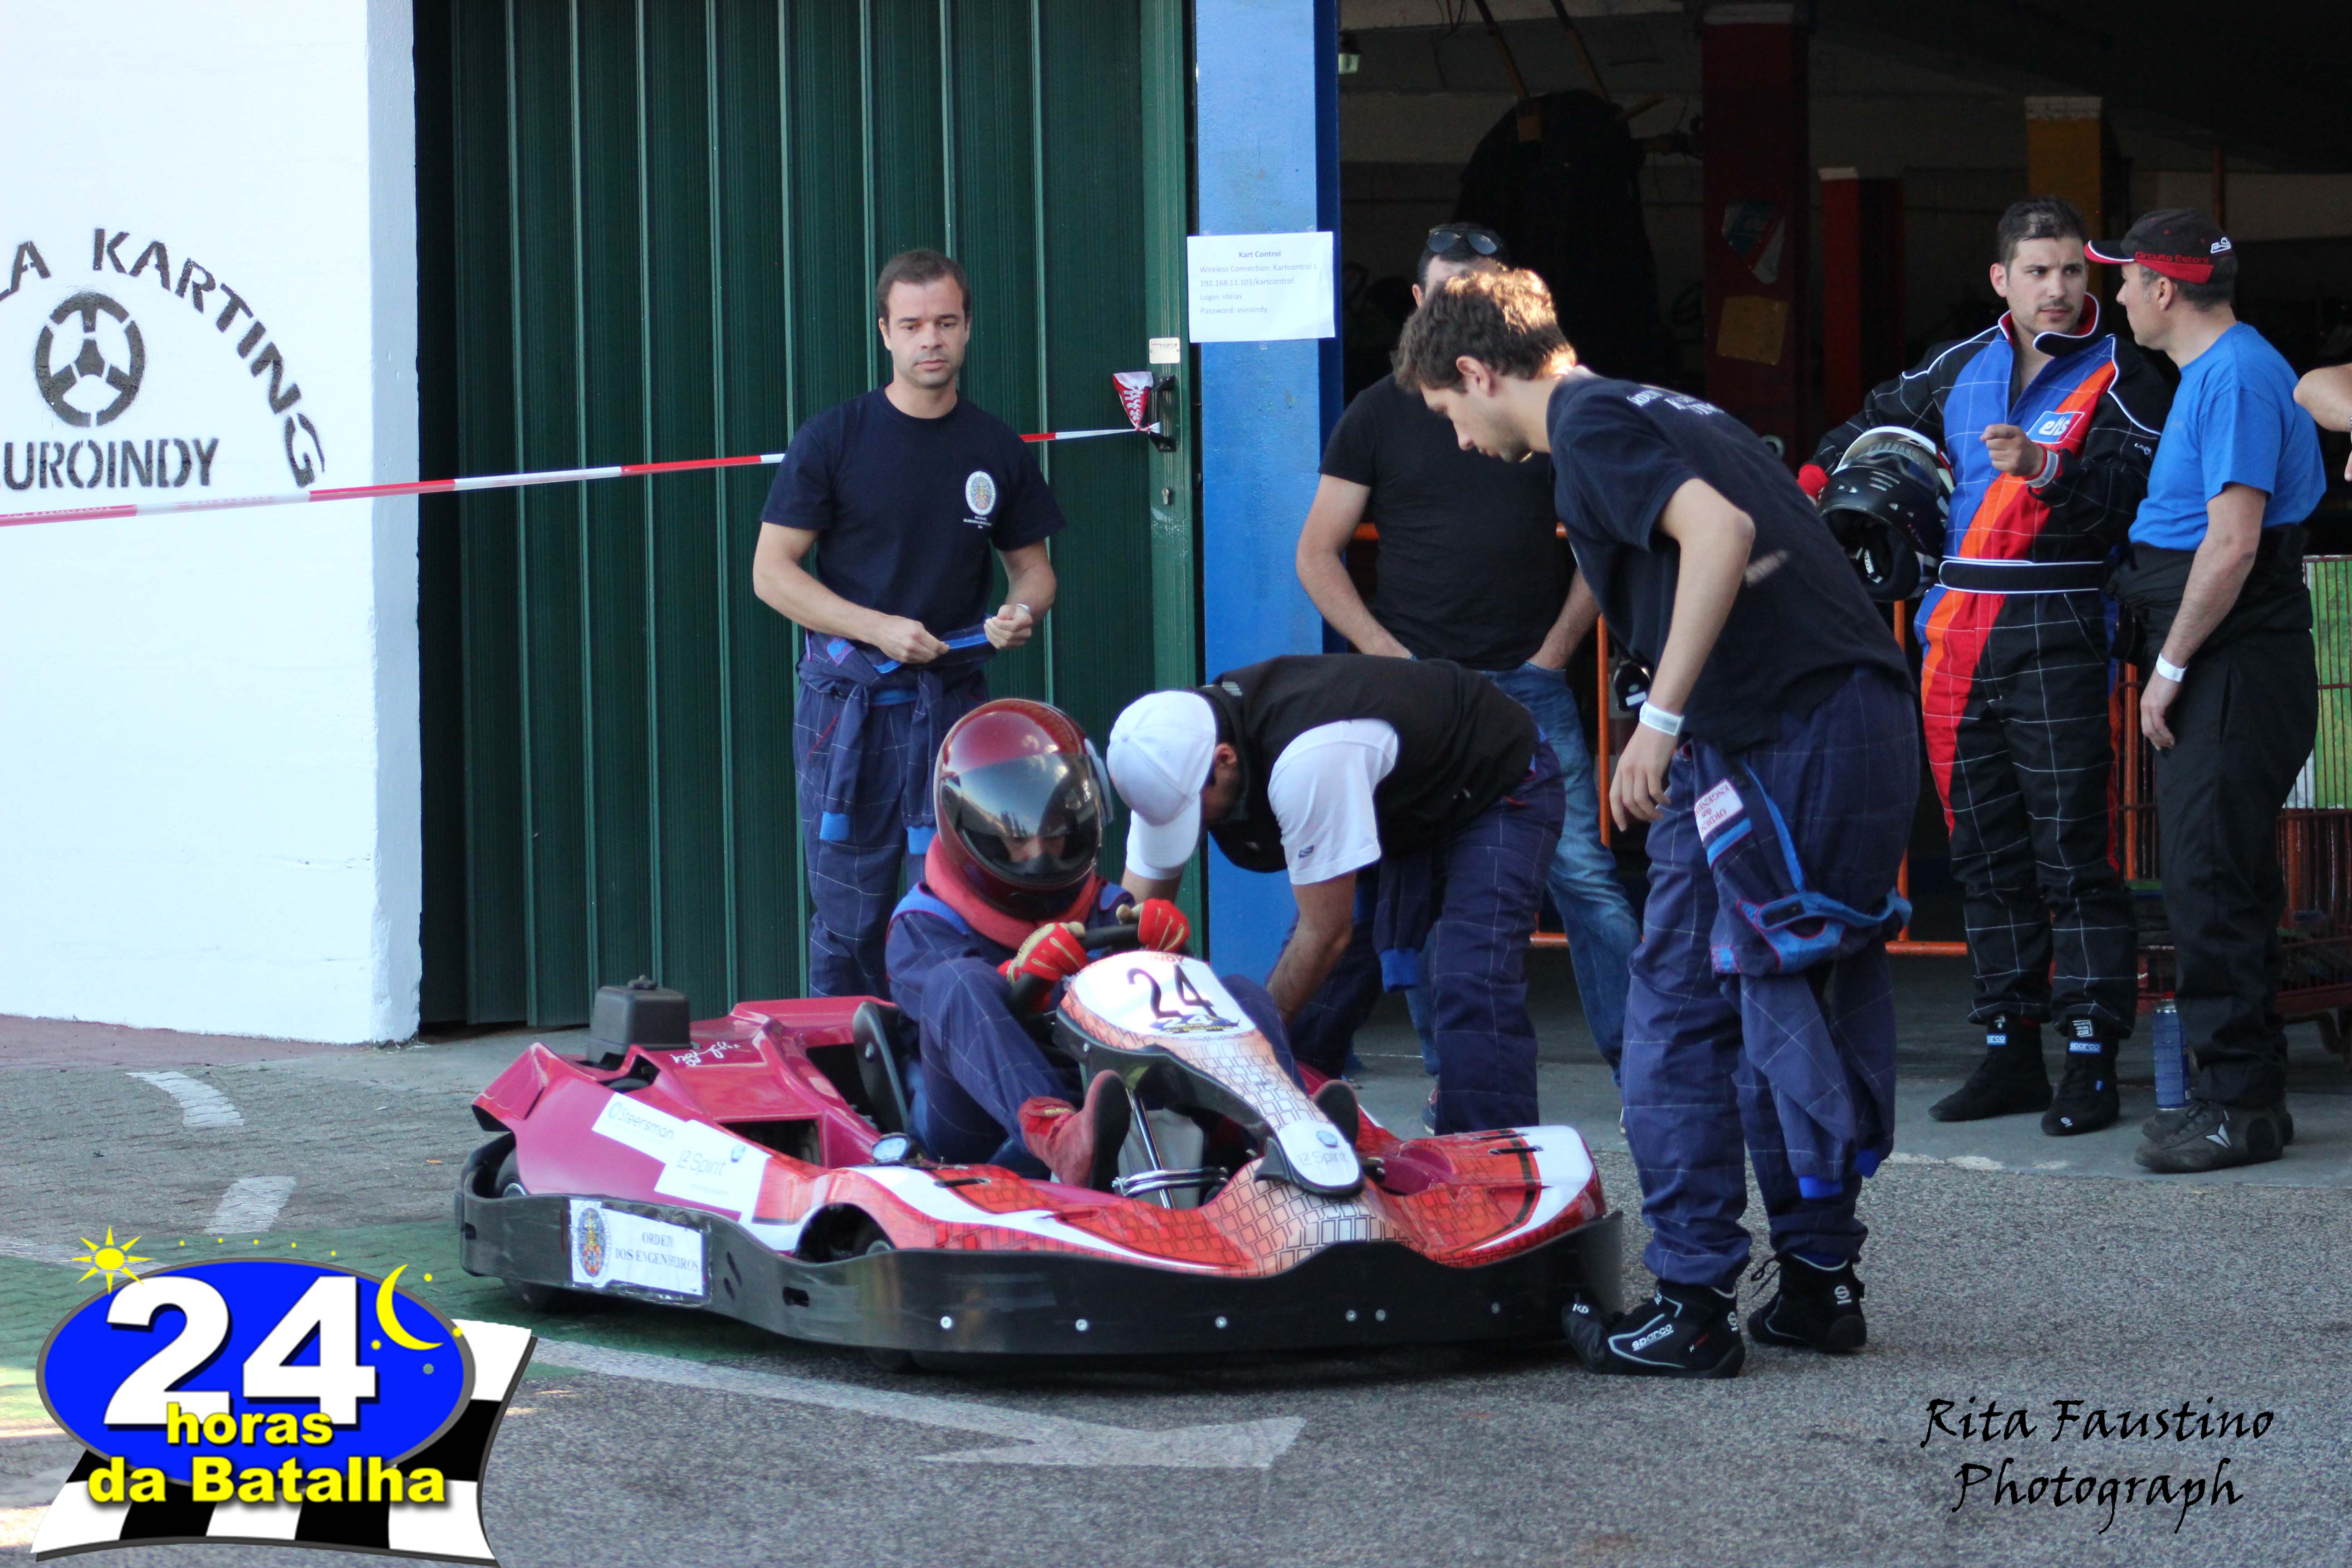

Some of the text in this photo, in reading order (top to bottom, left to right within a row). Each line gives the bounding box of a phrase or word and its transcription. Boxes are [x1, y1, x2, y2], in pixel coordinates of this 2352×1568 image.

[93, 228, 325, 487] KARTING
[4, 438, 219, 490] UROINDY
[1127, 965, 1218, 1019] 24
[617, 1108, 675, 1141] Steersman
[690, 1152, 726, 1176] Spirit
[1312, 1151, 1349, 1166] Spirit
[615, 1248, 633, 1260] DOS
[642, 1232, 674, 1248] ORDEM
[1632, 1323, 1674, 1352] sparco
